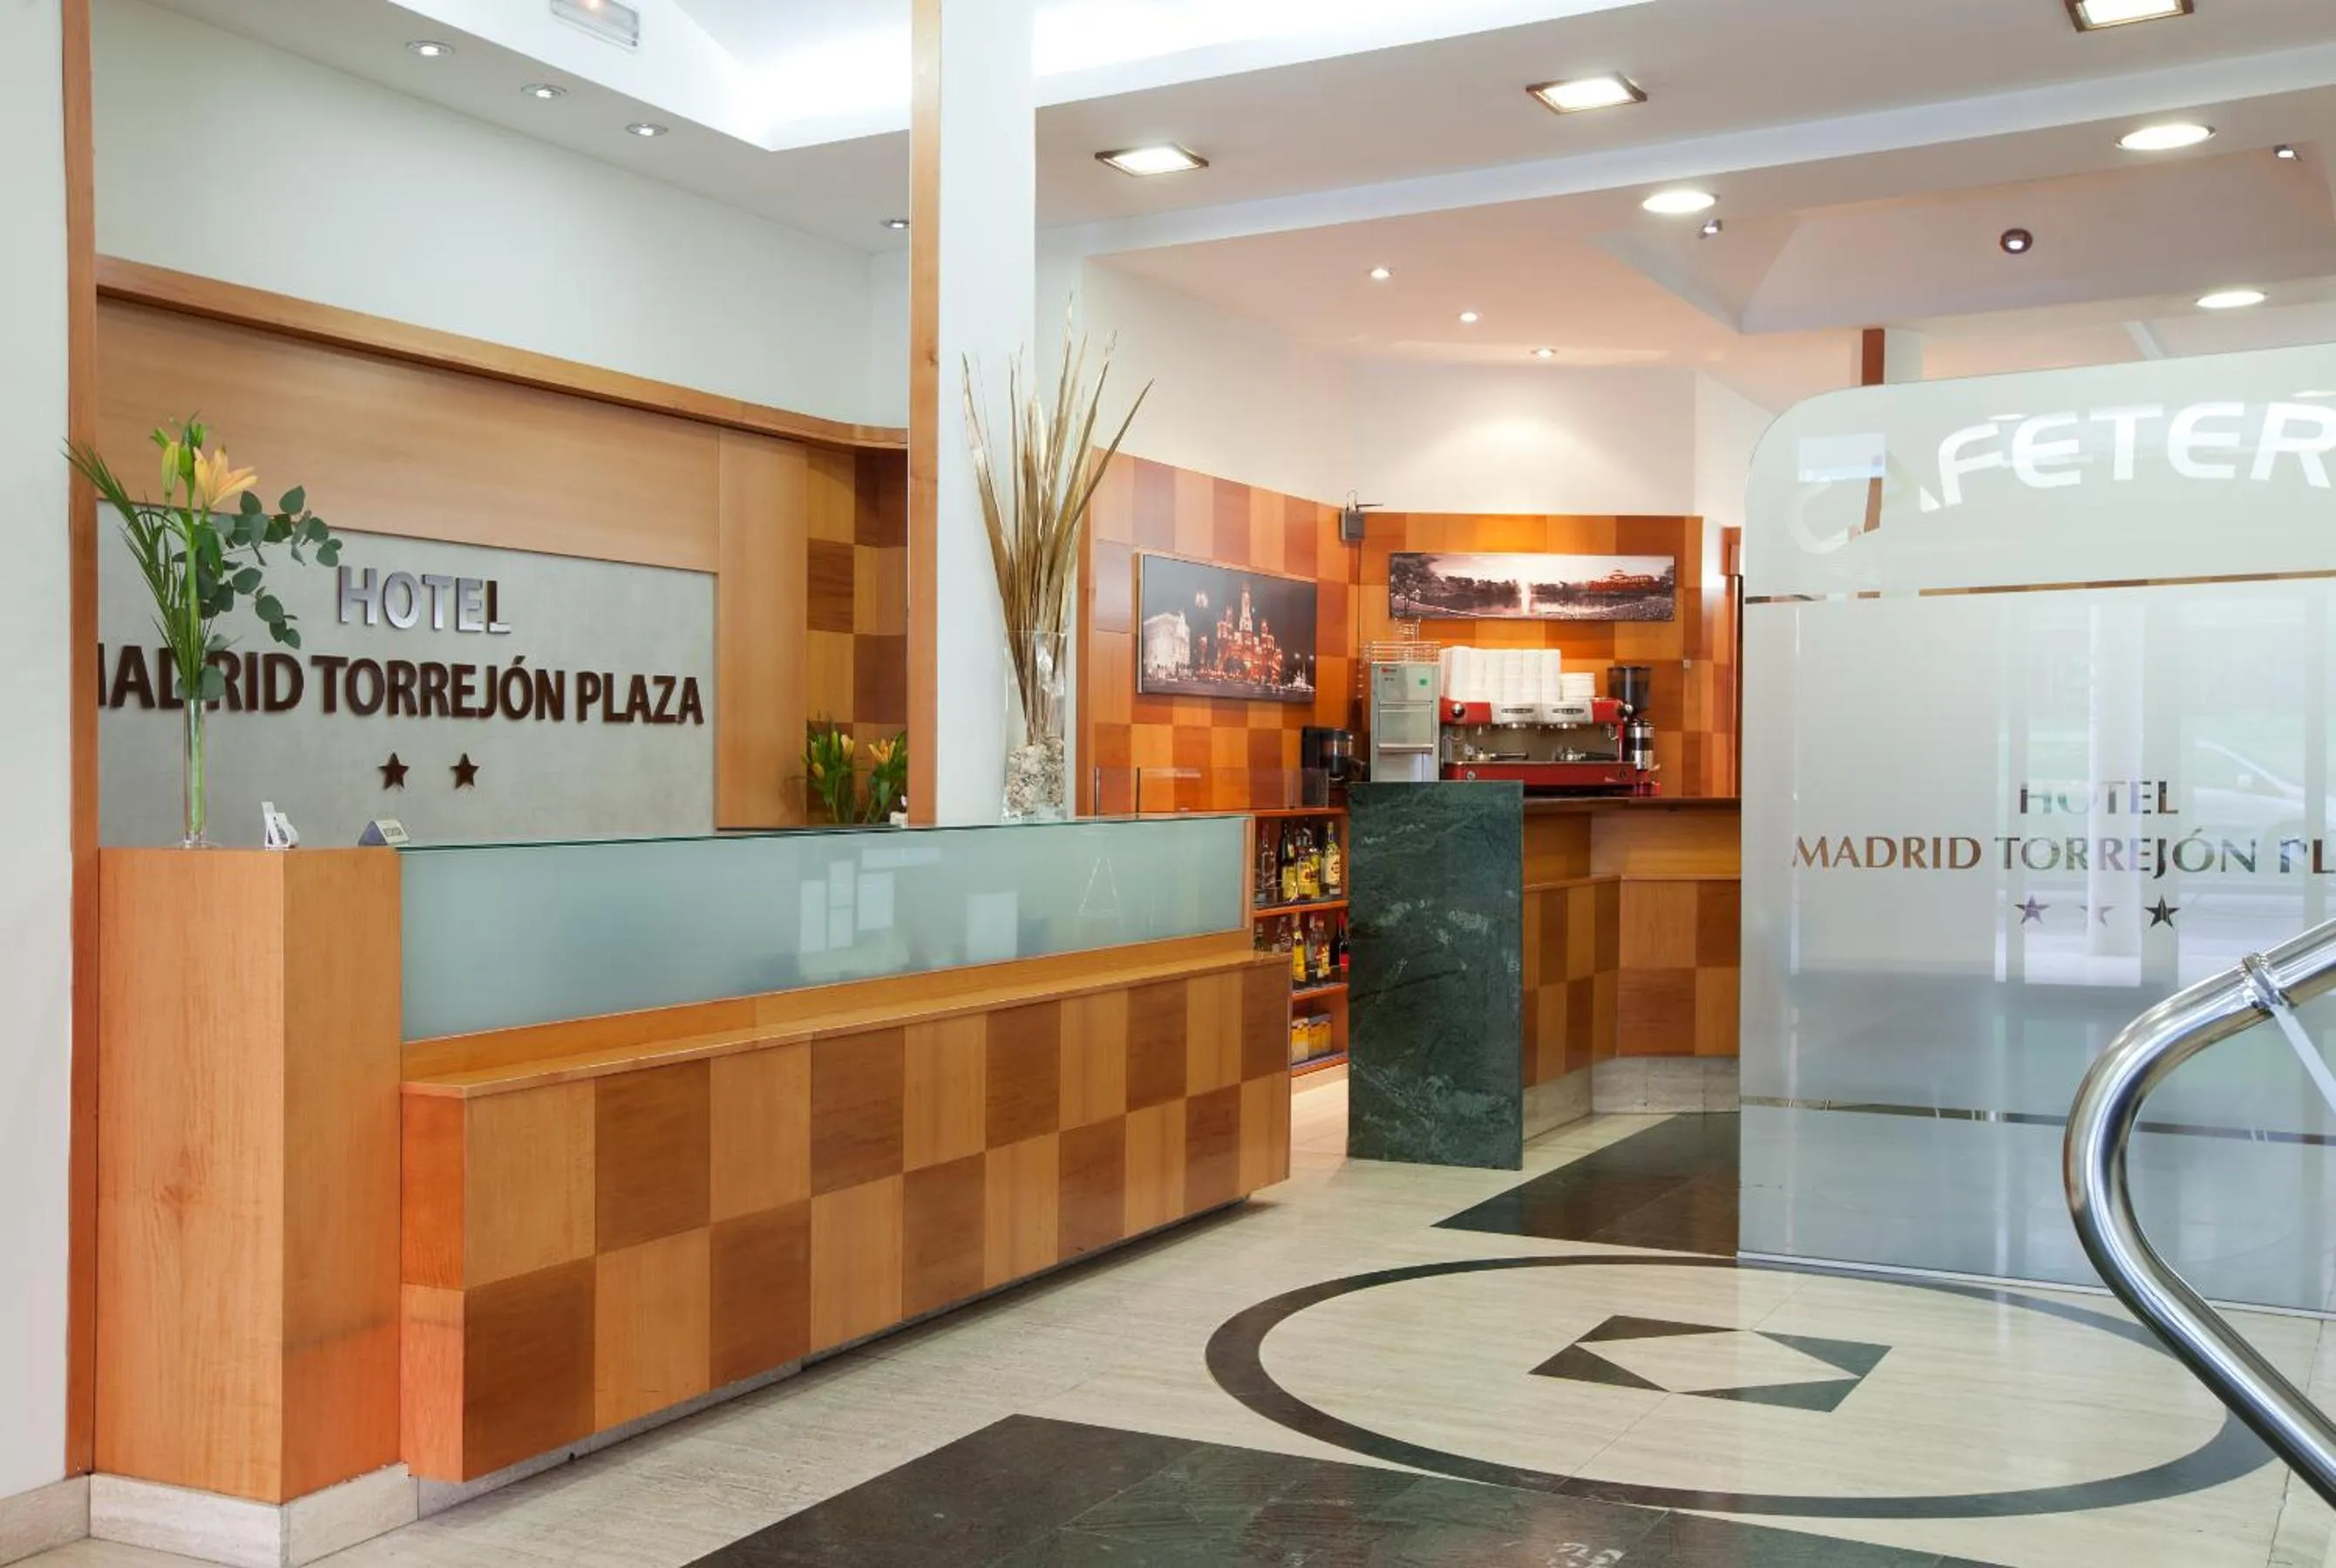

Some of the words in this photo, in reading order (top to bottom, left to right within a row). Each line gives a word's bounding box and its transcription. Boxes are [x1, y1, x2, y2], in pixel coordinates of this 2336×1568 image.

[336, 565, 511, 635] HOTEL
[310, 655, 566, 720] TORREJÓN
[576, 670, 704, 725] PLAZA
[2019, 780, 2179, 815] HOTEL
[1791, 834, 1983, 870] MADRID
[1993, 827, 2257, 879] TORREJÓN
